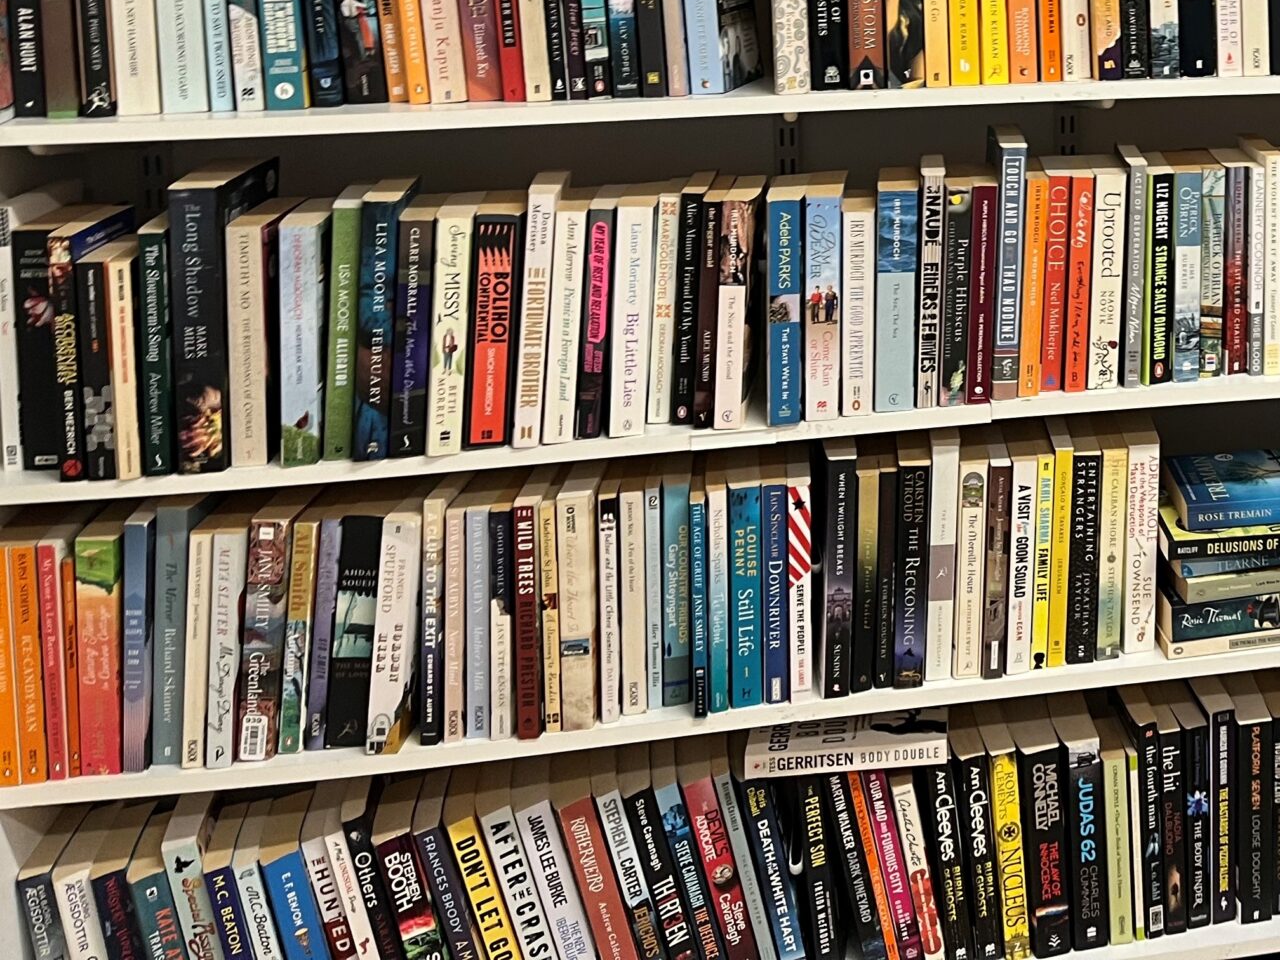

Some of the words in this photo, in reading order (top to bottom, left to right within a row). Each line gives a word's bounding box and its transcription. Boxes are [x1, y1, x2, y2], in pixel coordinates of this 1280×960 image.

[17, 8, 34, 41] ALAN
[20, 43, 36, 72] HUNT
[1004, 161, 1019, 198] TOUCH
[1157, 182, 1168, 200] LIZ
[779, 211, 791, 245] Adele
[1004, 202, 1018, 224] AND
[1048, 186, 1067, 272] CHOICE
[1156, 202, 1168, 240] NUGENT
[376, 223, 387, 255] LISA
[1004, 227, 1016, 244] GO
[1097, 191, 1121, 279] Uprooted
[778, 248, 791, 289] PARKS
[1002, 265, 1015, 292] THAD
[1155, 245, 1167, 288] STRANGE
[374, 259, 385, 312] MOORE
[1154, 290, 1166, 316] SALLY
[623, 312, 639, 335] Big
[1000, 296, 1014, 340] NODINE
[625, 339, 639, 376] Little
[1153, 318, 1166, 360] DIAMOND
[369, 329, 383, 404] FEBRUARY
[622, 378, 638, 408] Lies
[1198, 512, 1226, 522] ROSE
[1229, 509, 1272, 519] TREMAIN
[735, 529, 746, 576] PENNY
[746, 526, 756, 578] LOUISE
[1207, 539, 1263, 555] DELUSIONS
[1266, 538, 1277, 551] OF
[737, 589, 753, 622] Still
[767, 561, 783, 650] DOWNRIVER
[903, 557, 920, 646] RECKONING
[738, 627, 754, 657] Life
[777, 753, 854, 771] GERRITSEN
[860, 750, 890, 763] BODY
[894, 748, 939, 760] DOUBLE
[1079, 777, 1094, 836] JUDAS
[1081, 839, 1096, 863] 62
[213, 875, 230, 906] M.C.
[384, 853, 413, 912] BOOTH
[455, 835, 490, 897] DON'T
[476, 896, 496, 932] LET
[1000, 845, 1027, 928] NUCLEUS
[221, 907, 242, 954] BEATON
